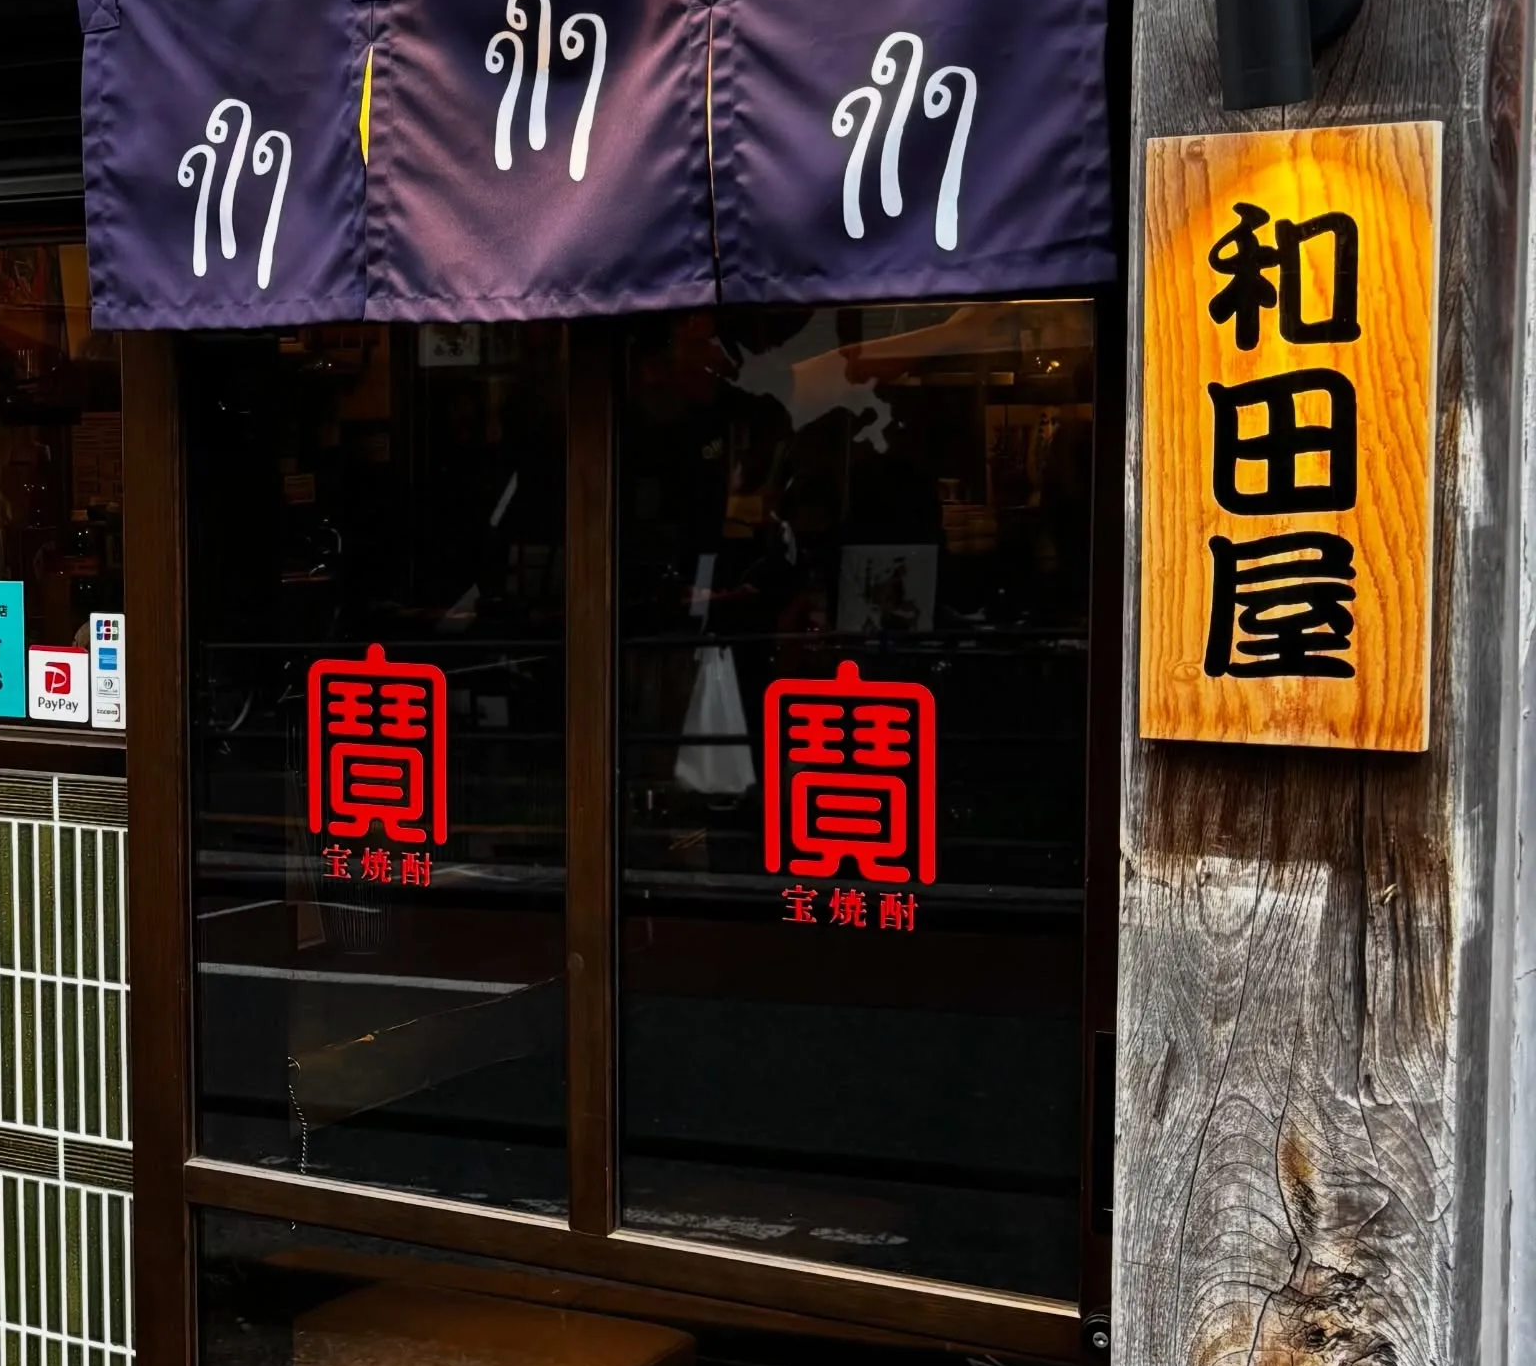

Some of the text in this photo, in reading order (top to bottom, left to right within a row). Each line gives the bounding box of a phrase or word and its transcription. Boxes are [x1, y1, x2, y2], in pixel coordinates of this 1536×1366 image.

[1202, 201, 1362, 680] 和田屋
[37, 696, 79, 713] PayPay
[321, 844, 434, 890] 宝焼酎
[780, 884, 920, 933] 宝焼酎
